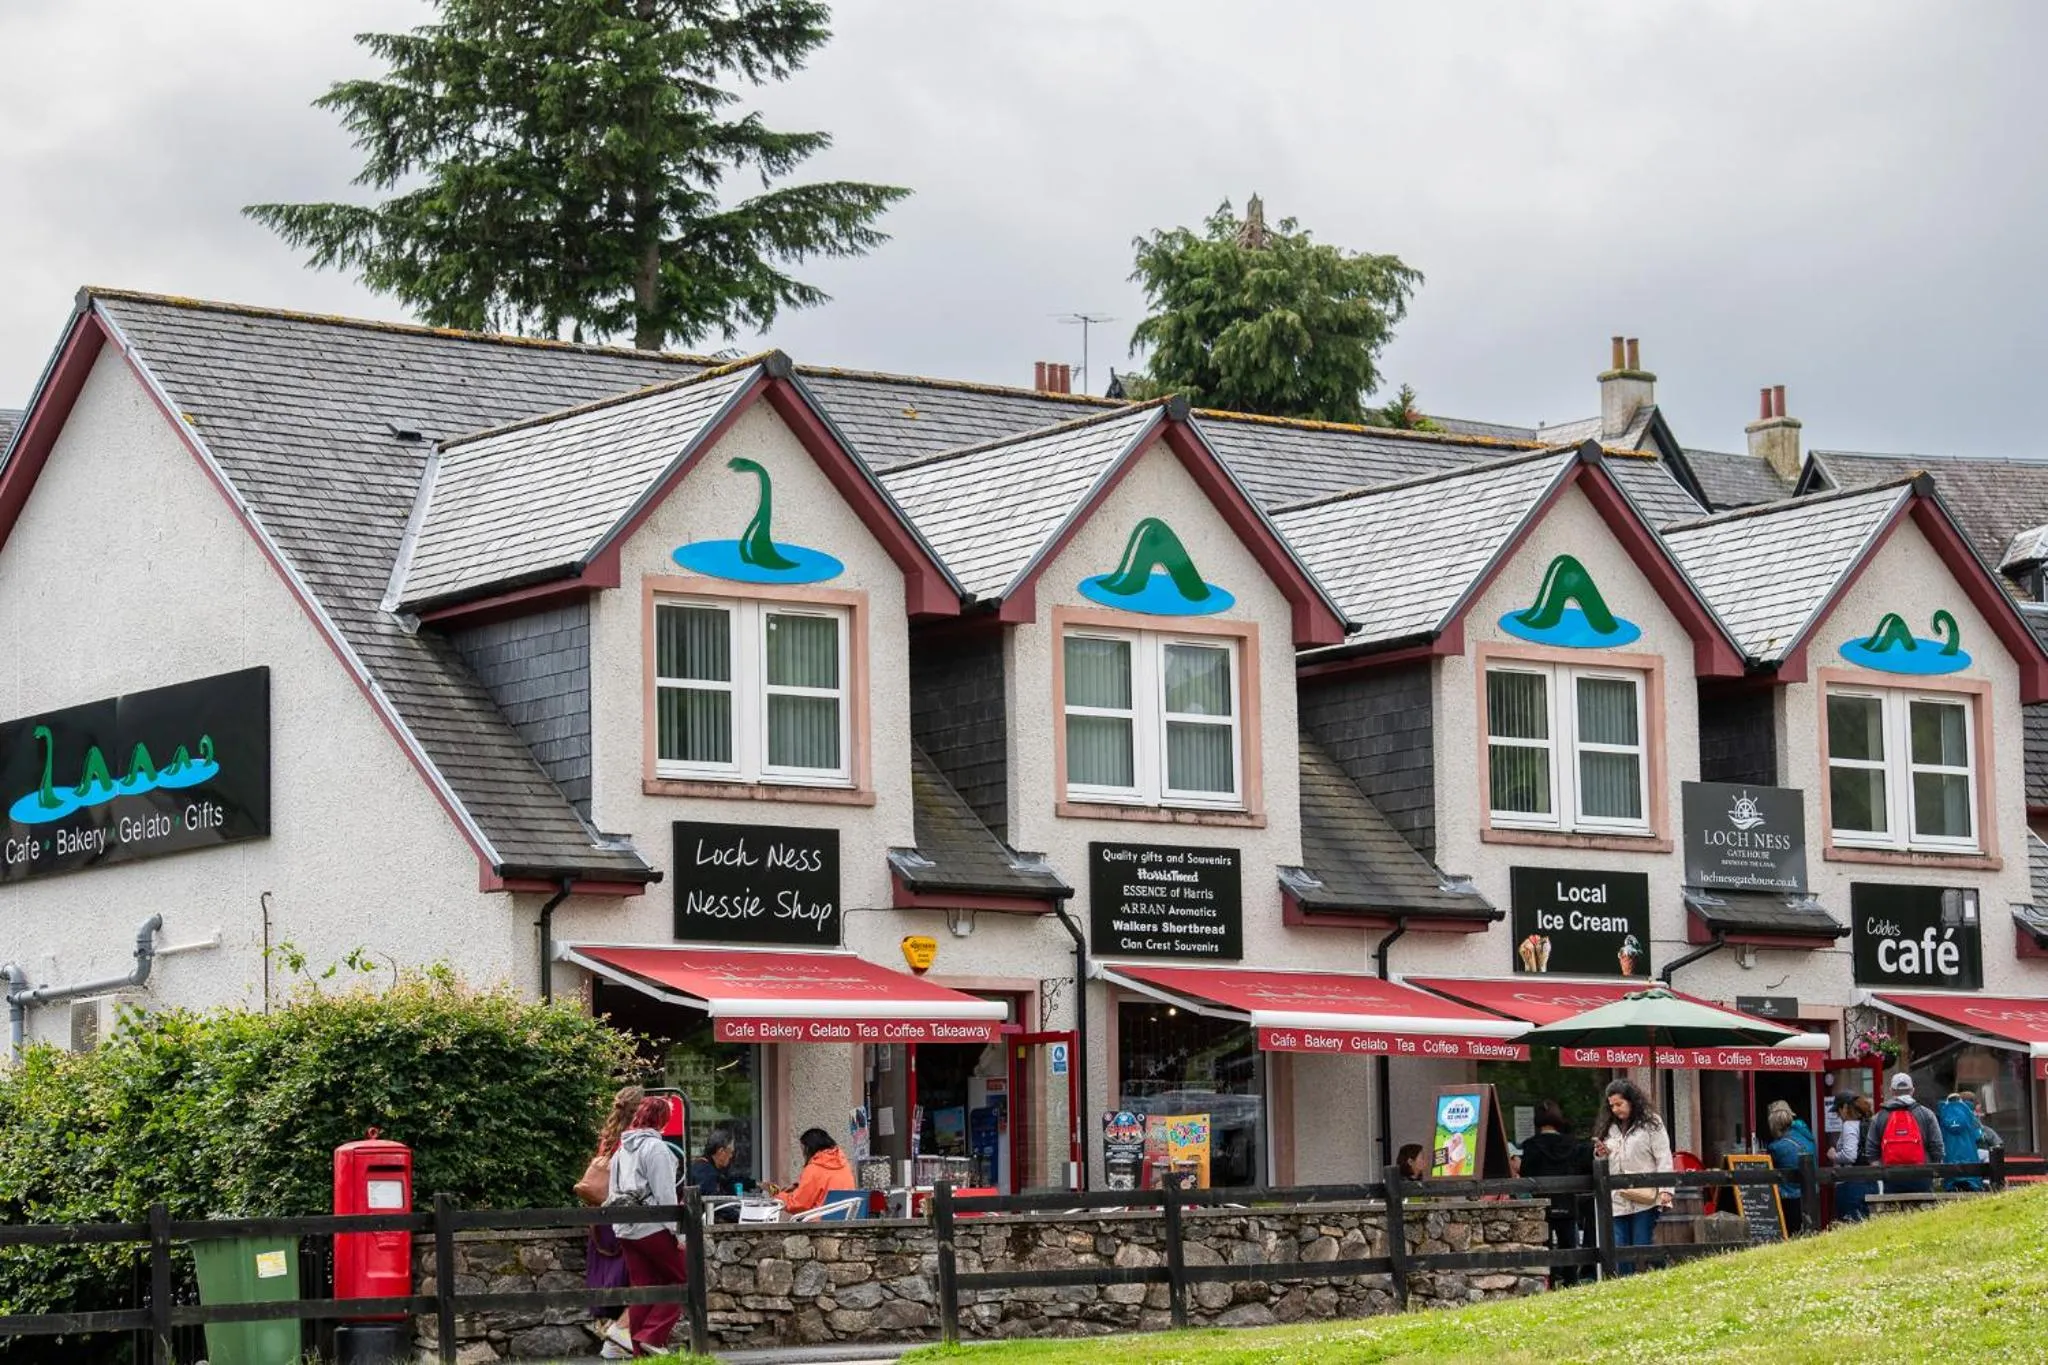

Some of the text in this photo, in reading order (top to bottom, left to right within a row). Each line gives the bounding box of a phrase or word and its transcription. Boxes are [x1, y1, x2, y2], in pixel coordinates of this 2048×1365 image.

[6, 801, 224, 864] Cafe Bakery Gelato Gifts
[1704, 829, 1791, 850] LOCH NESS
[696, 838, 822, 872] Loch Ness
[1102, 849, 1232, 866] Quality gifts and Souvenirs
[1122, 885, 1214, 900] ESSENCE of Harris
[1557, 881, 1607, 903] Local
[686, 887, 833, 932] Nessie Shop
[1120, 902, 1217, 917] ARRAN Aromatics
[1112, 920, 1226, 935] Walkers Shortbread
[1537, 909, 1628, 933] Ice Cream
[1866, 916, 1901, 936] Cobbs
[1120, 938, 1219, 952] Clan Crest Souvenirs
[1878, 926, 1960, 976] café
[725, 1022, 991, 1040] Cafe Bakery Gelato Tea Coffee Takeaway
[1270, 1033, 1520, 1058] Cafe Bakery Gelato Tea Coffee Takeaway
[1574, 1048, 1600, 1062] Cafe
[1606, 1049, 1644, 1066] Bakery
[1692, 1051, 1712, 1064] Tea
[1718, 1052, 1752, 1066] Coffee
[1758, 1052, 1810, 1068] Takeaway
